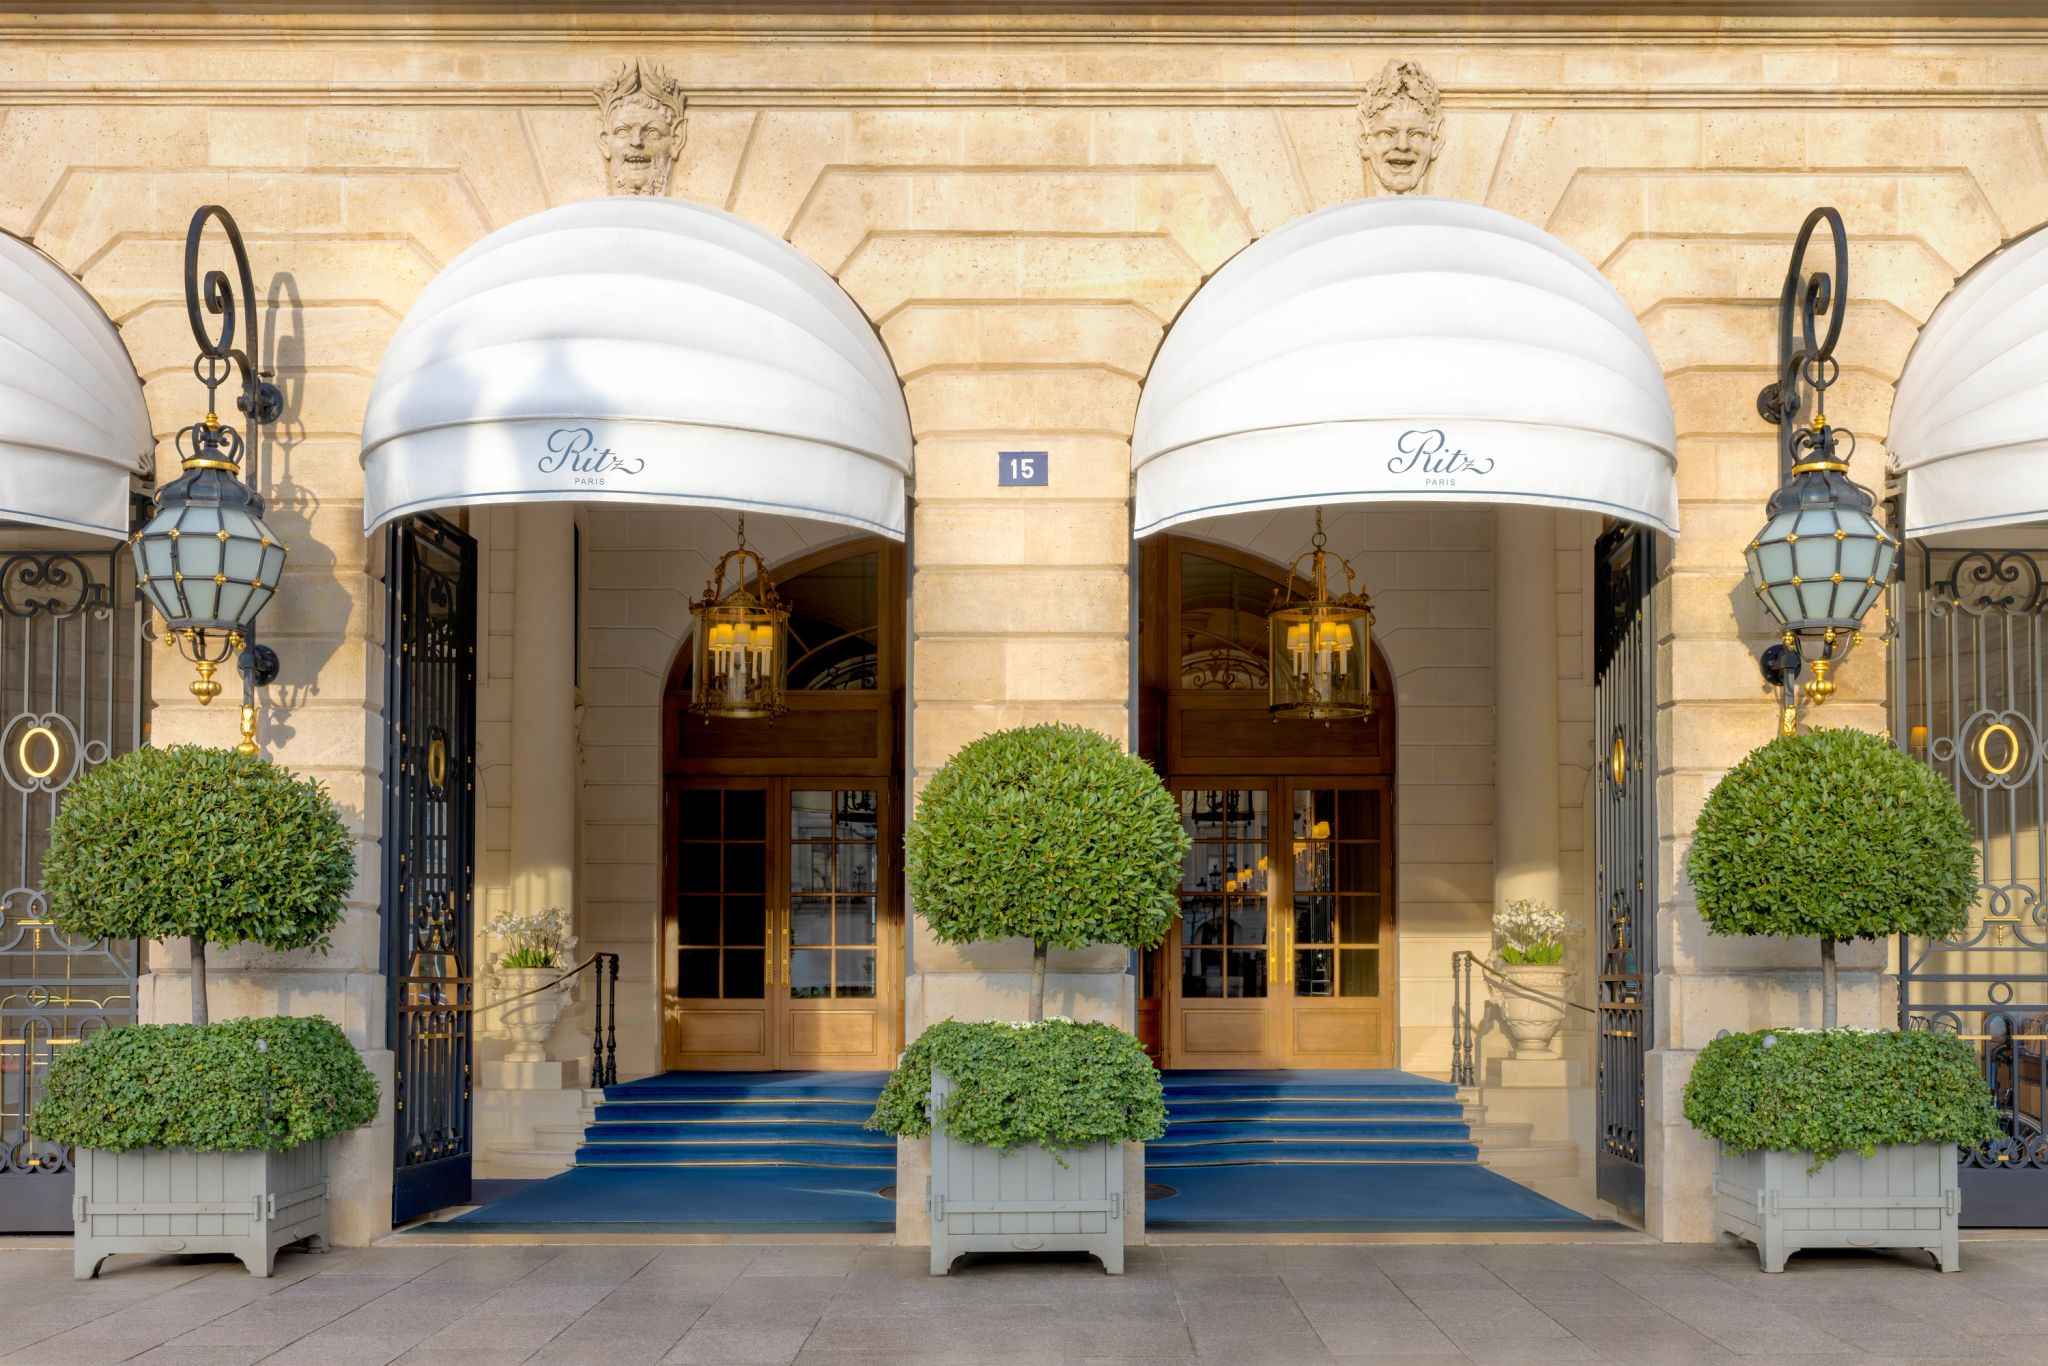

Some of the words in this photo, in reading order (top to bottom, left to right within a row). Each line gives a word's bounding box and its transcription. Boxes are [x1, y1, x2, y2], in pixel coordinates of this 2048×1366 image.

[538, 427, 645, 475] Ritz
[1387, 428, 1495, 475] Ritz
[1010, 458, 1035, 480] 15
[574, 477, 606, 486] PARIS
[1425, 478, 1457, 487] PARIS
